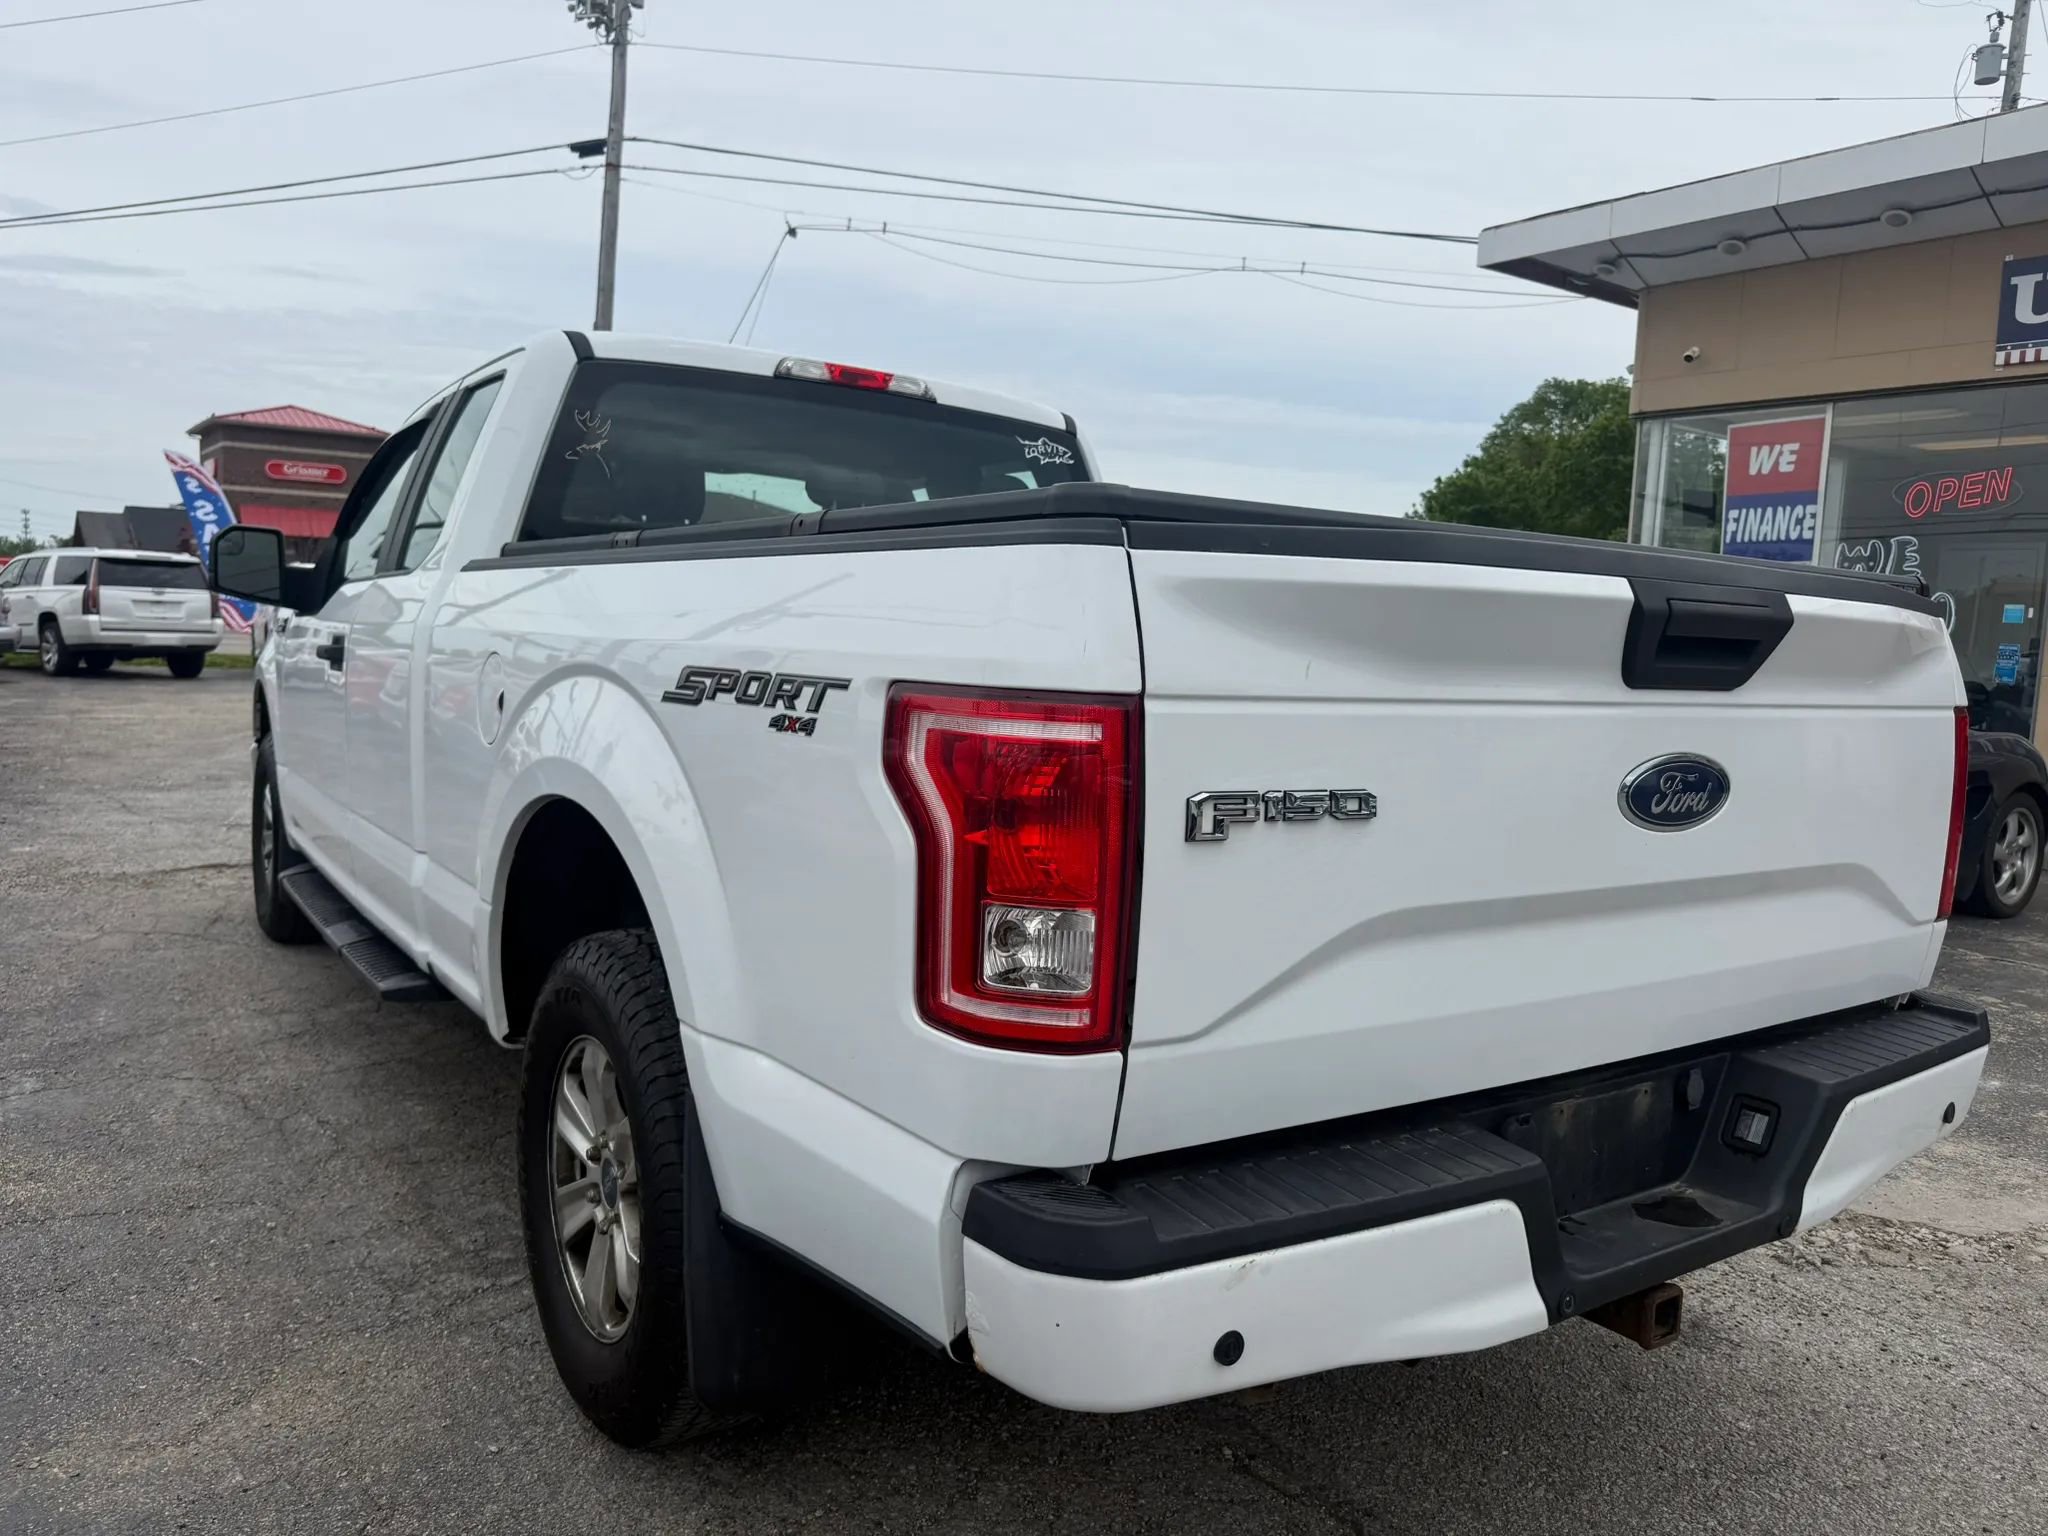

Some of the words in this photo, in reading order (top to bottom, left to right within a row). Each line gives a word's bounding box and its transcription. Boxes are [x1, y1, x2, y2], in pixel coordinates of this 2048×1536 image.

[1748, 442, 1800, 475] WE
[1904, 466, 2013, 519] OPEN
[1725, 504, 1818, 544] FINANCE
[661, 665, 853, 714] SPORT
[1185, 788, 1377, 842] F150
[1651, 771, 1712, 815] Ford
